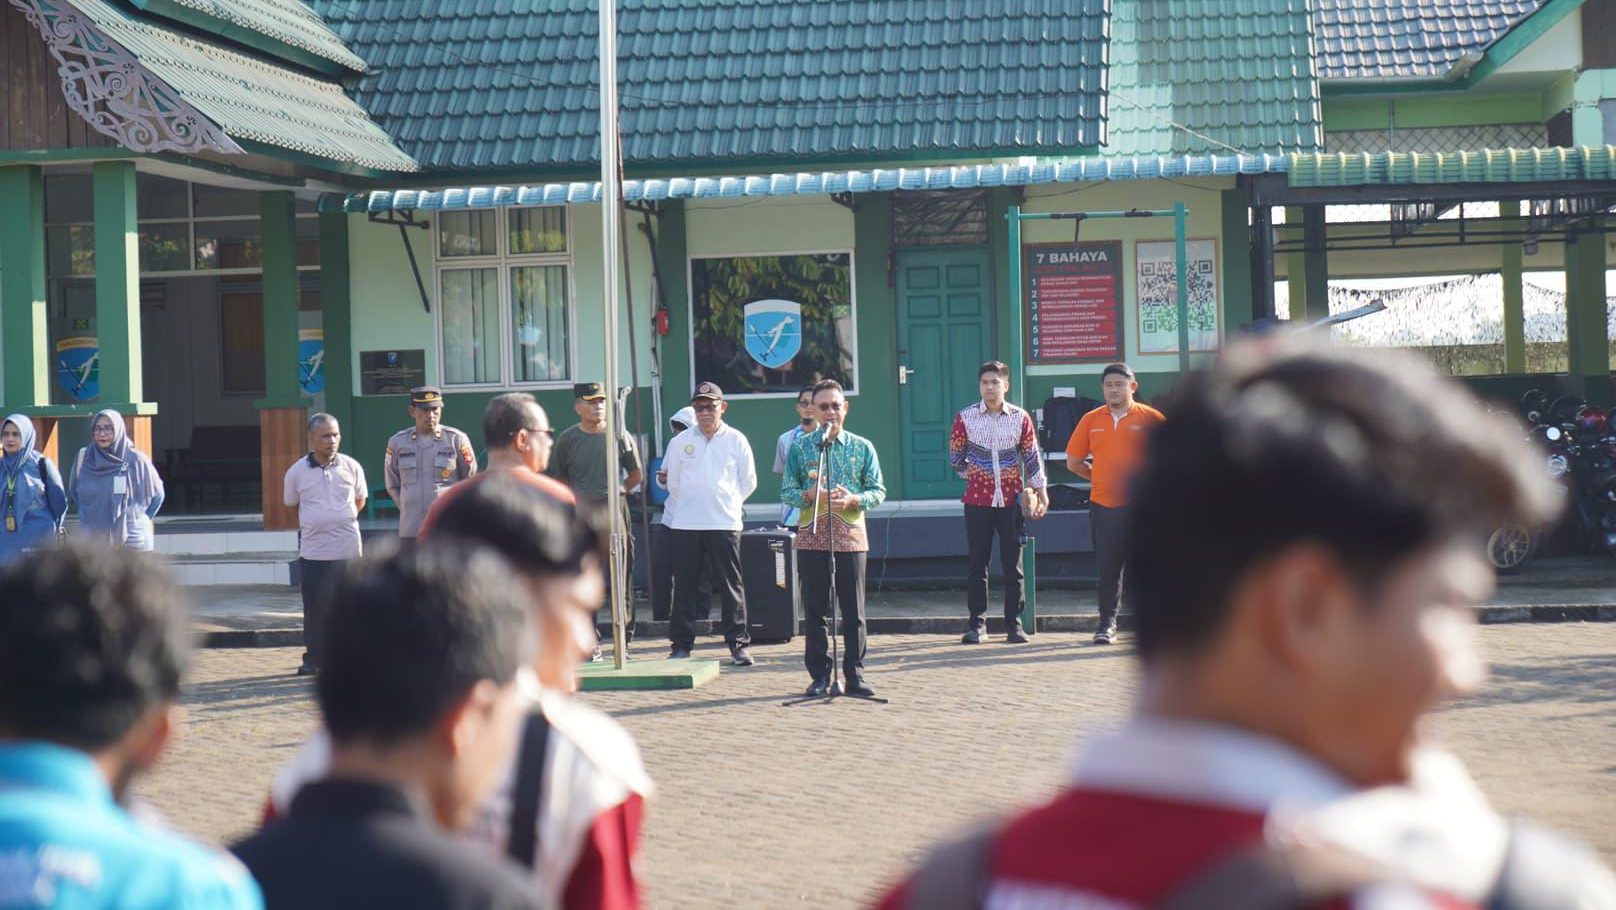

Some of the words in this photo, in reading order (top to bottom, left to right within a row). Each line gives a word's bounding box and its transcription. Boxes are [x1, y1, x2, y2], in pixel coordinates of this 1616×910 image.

[1036, 253, 1045, 264] 7
[1050, 251, 1107, 263] BAHAYA
[1031, 278, 1037, 287] 1
[1031, 290, 1038, 299] 2
[1032, 301, 1038, 310] 3
[1032, 314, 1038, 322] 4
[1032, 325, 1039, 334] 5
[1033, 338, 1039, 346] 6
[1033, 349, 1039, 358] 7
